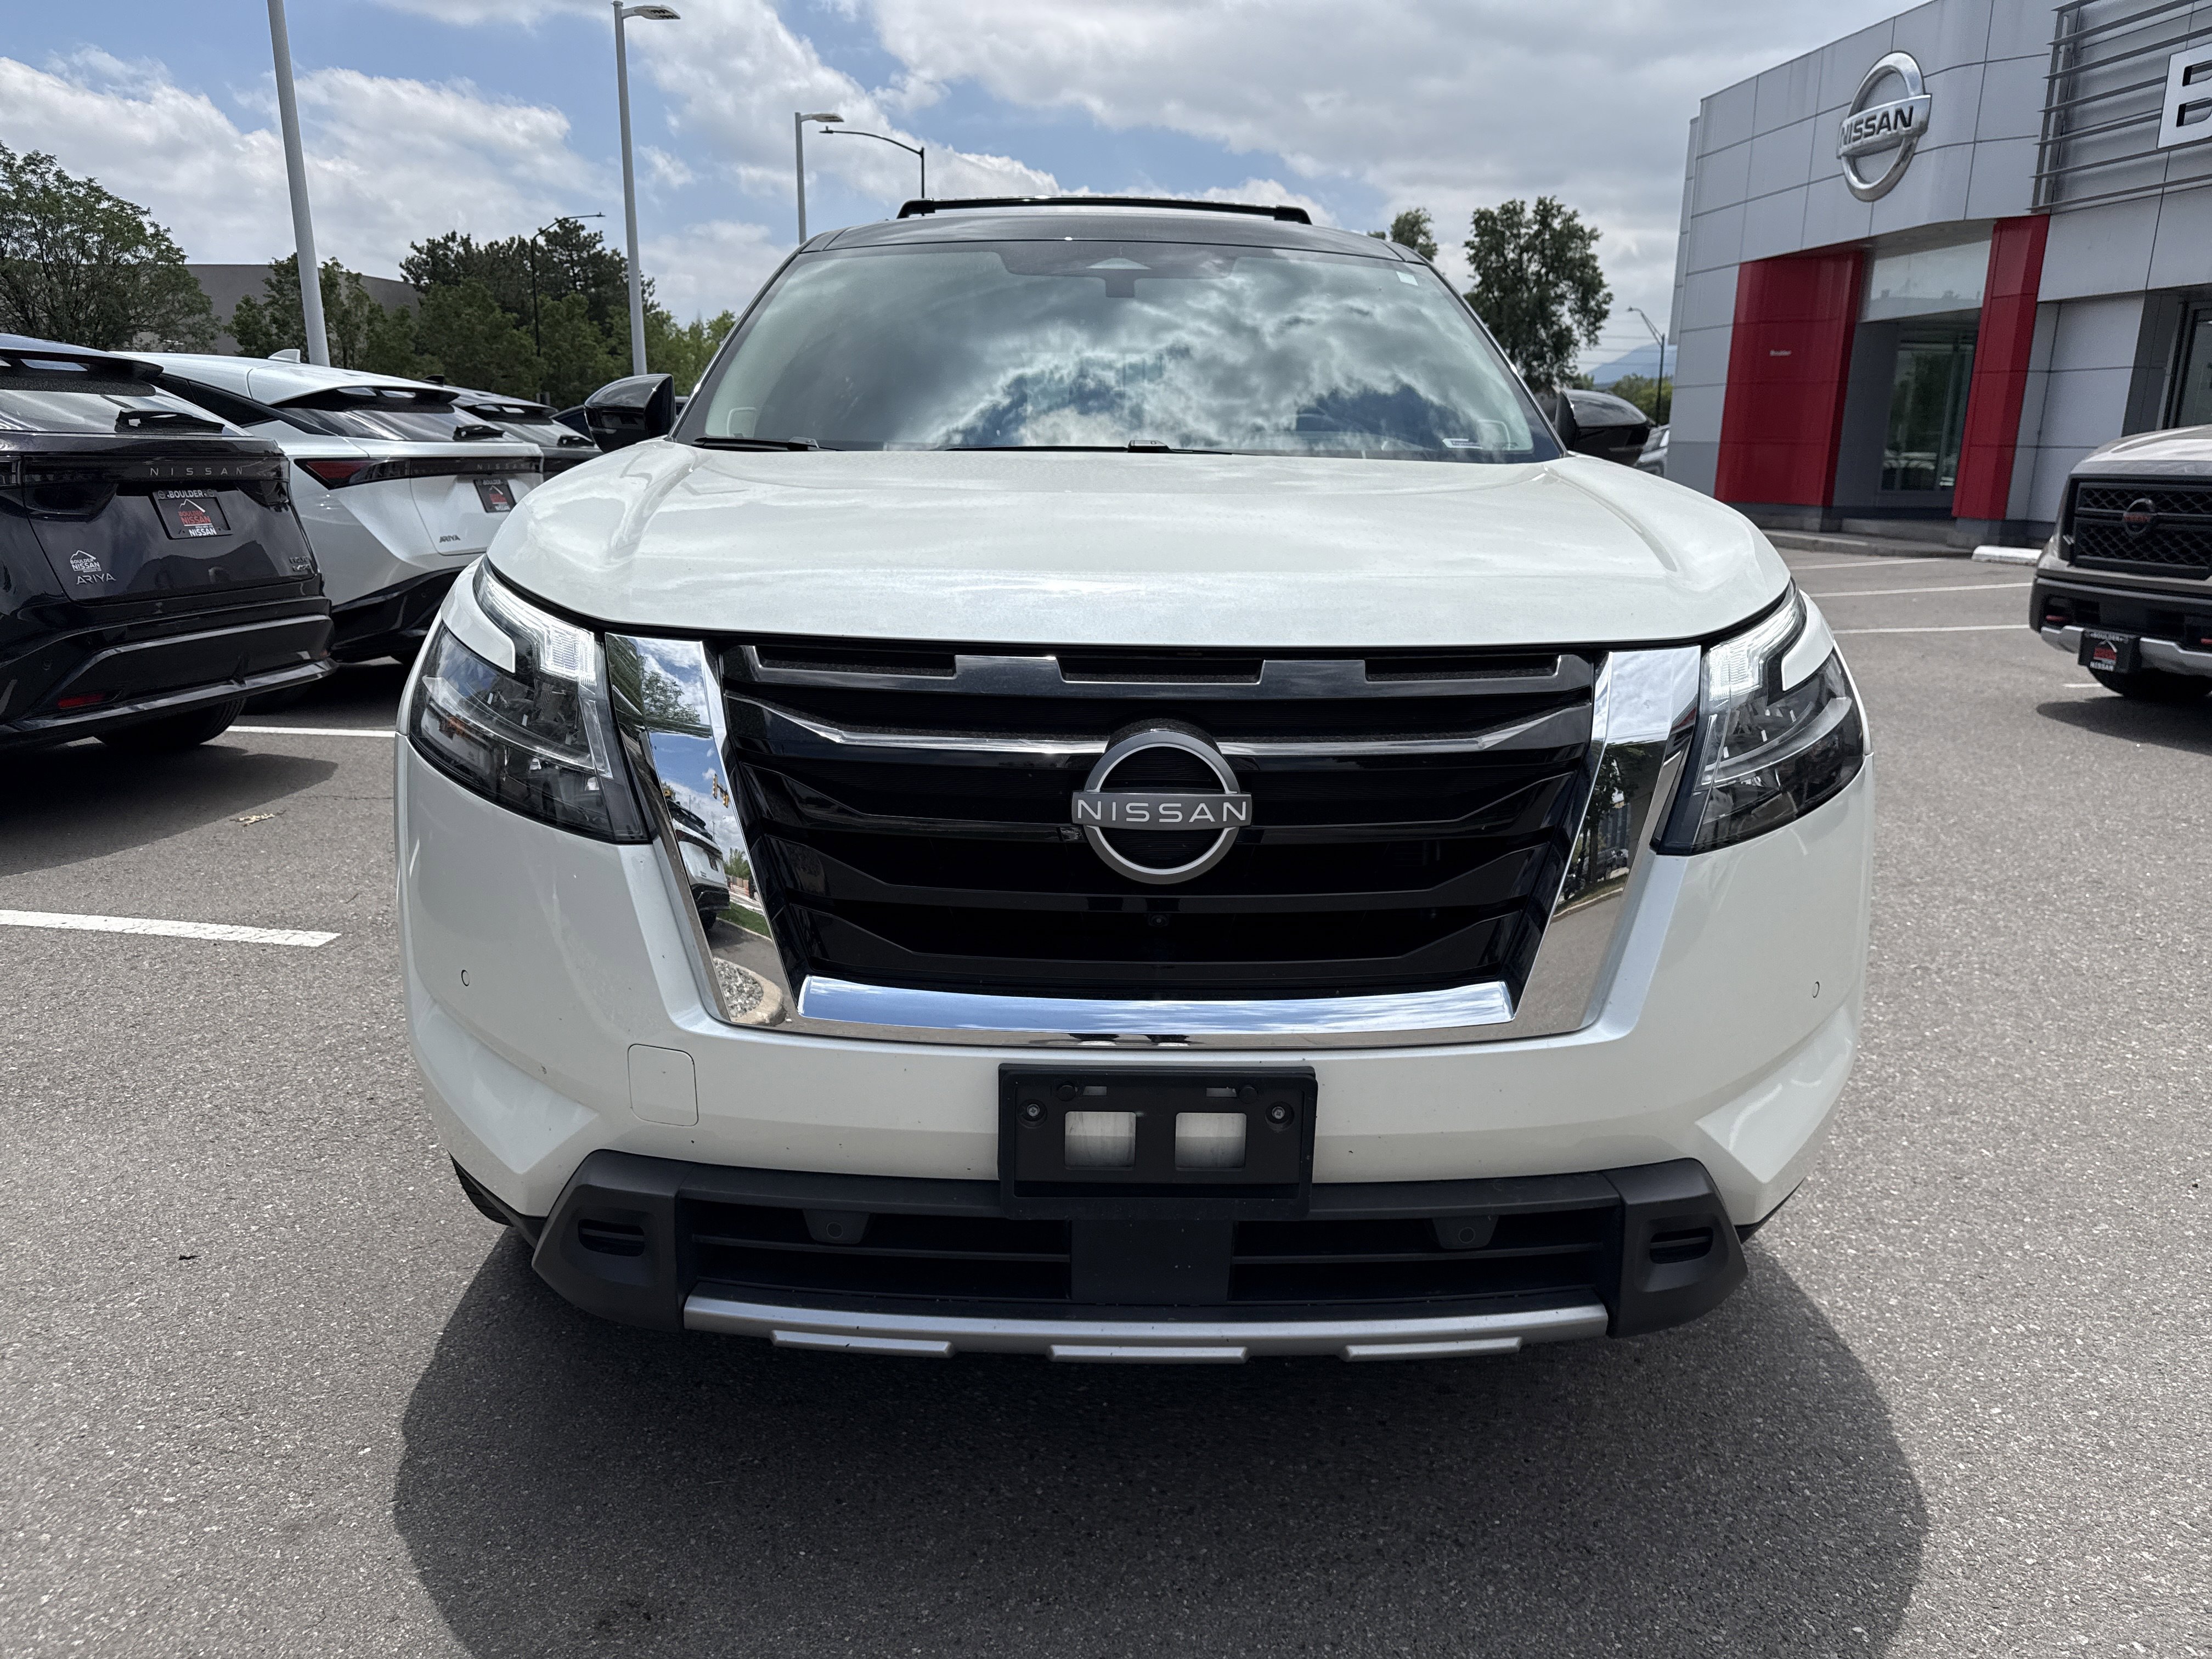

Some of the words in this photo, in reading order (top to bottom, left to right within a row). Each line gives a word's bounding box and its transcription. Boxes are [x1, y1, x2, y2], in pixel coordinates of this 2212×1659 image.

[1839, 105, 1914, 145] NISSAN
[150, 467, 242, 476] NISSAN
[168, 489, 204, 498] BOULDER
[181, 515, 211, 524] NISSAN
[188, 527, 217, 537] NISSAN
[439, 534, 461, 543] ARIYA
[71, 561, 100, 570] NISSAN
[76, 573, 117, 585] ARIYA
[1077, 799, 1247, 823] NISSAN
